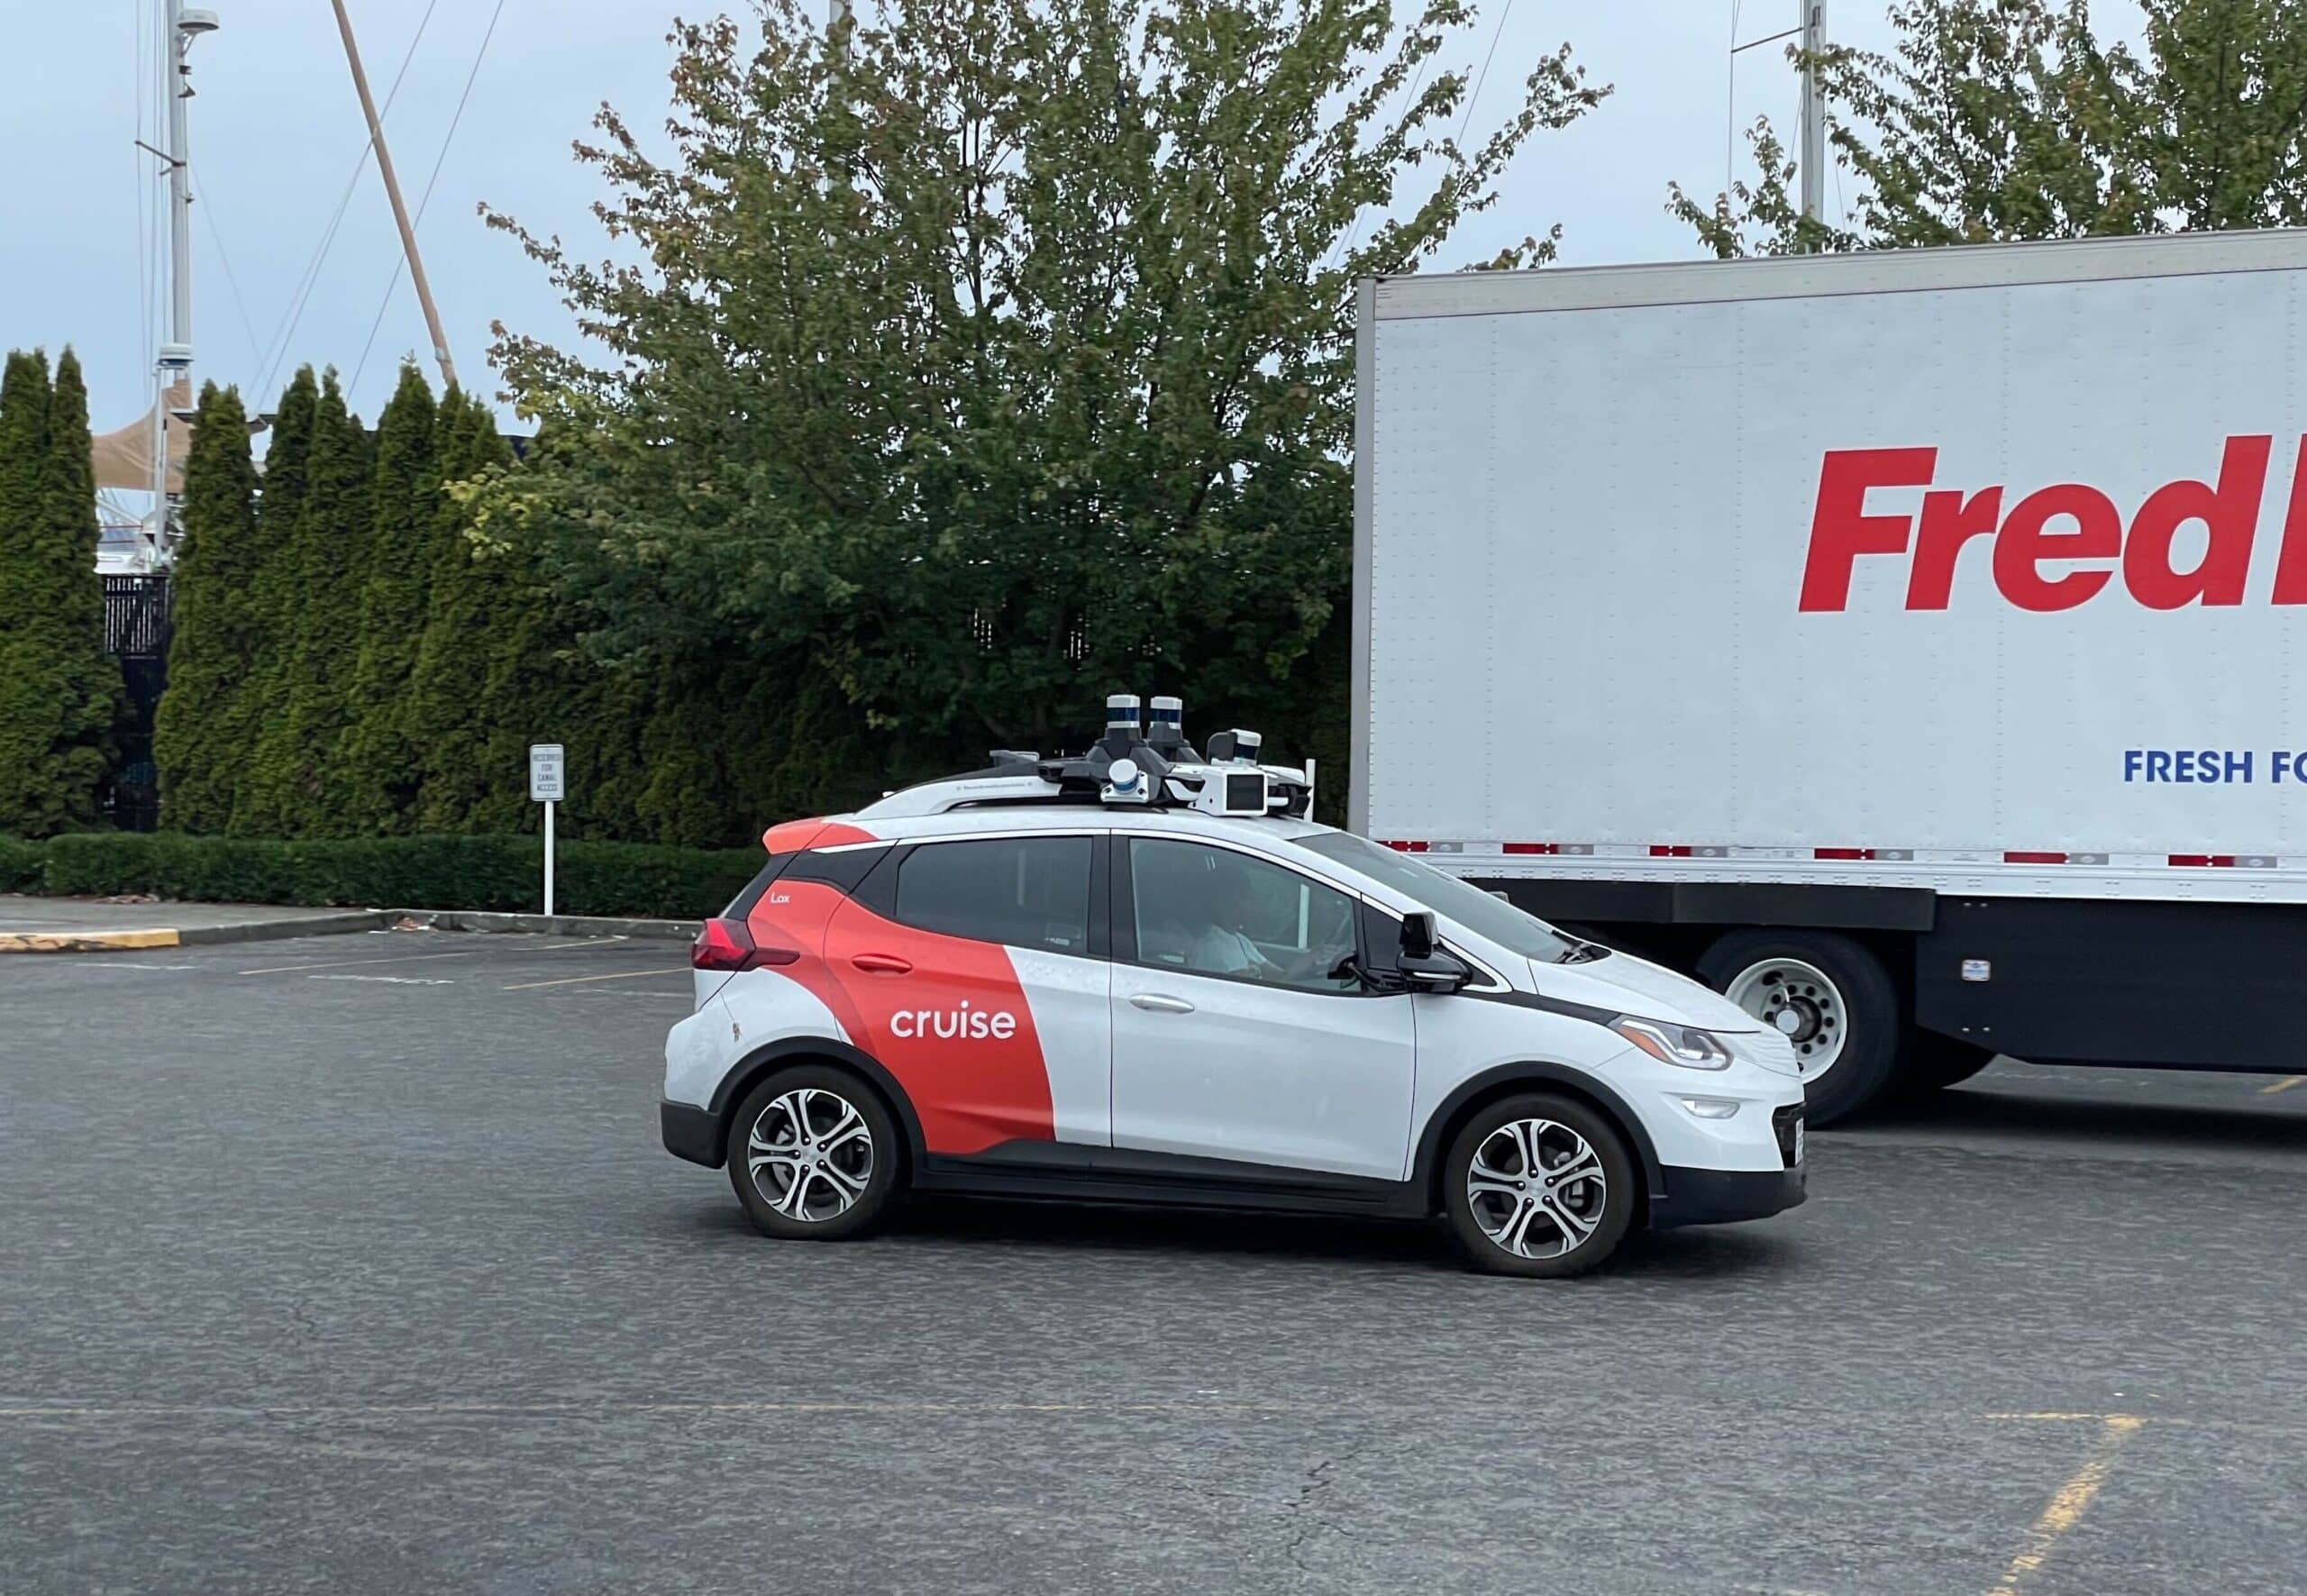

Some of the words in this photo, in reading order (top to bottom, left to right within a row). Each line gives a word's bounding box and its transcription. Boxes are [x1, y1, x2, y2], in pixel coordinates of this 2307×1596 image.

[1799, 433, 2273, 613] Fred
[2124, 750, 2254, 783] FRESH
[890, 999, 1017, 1039] cruise
